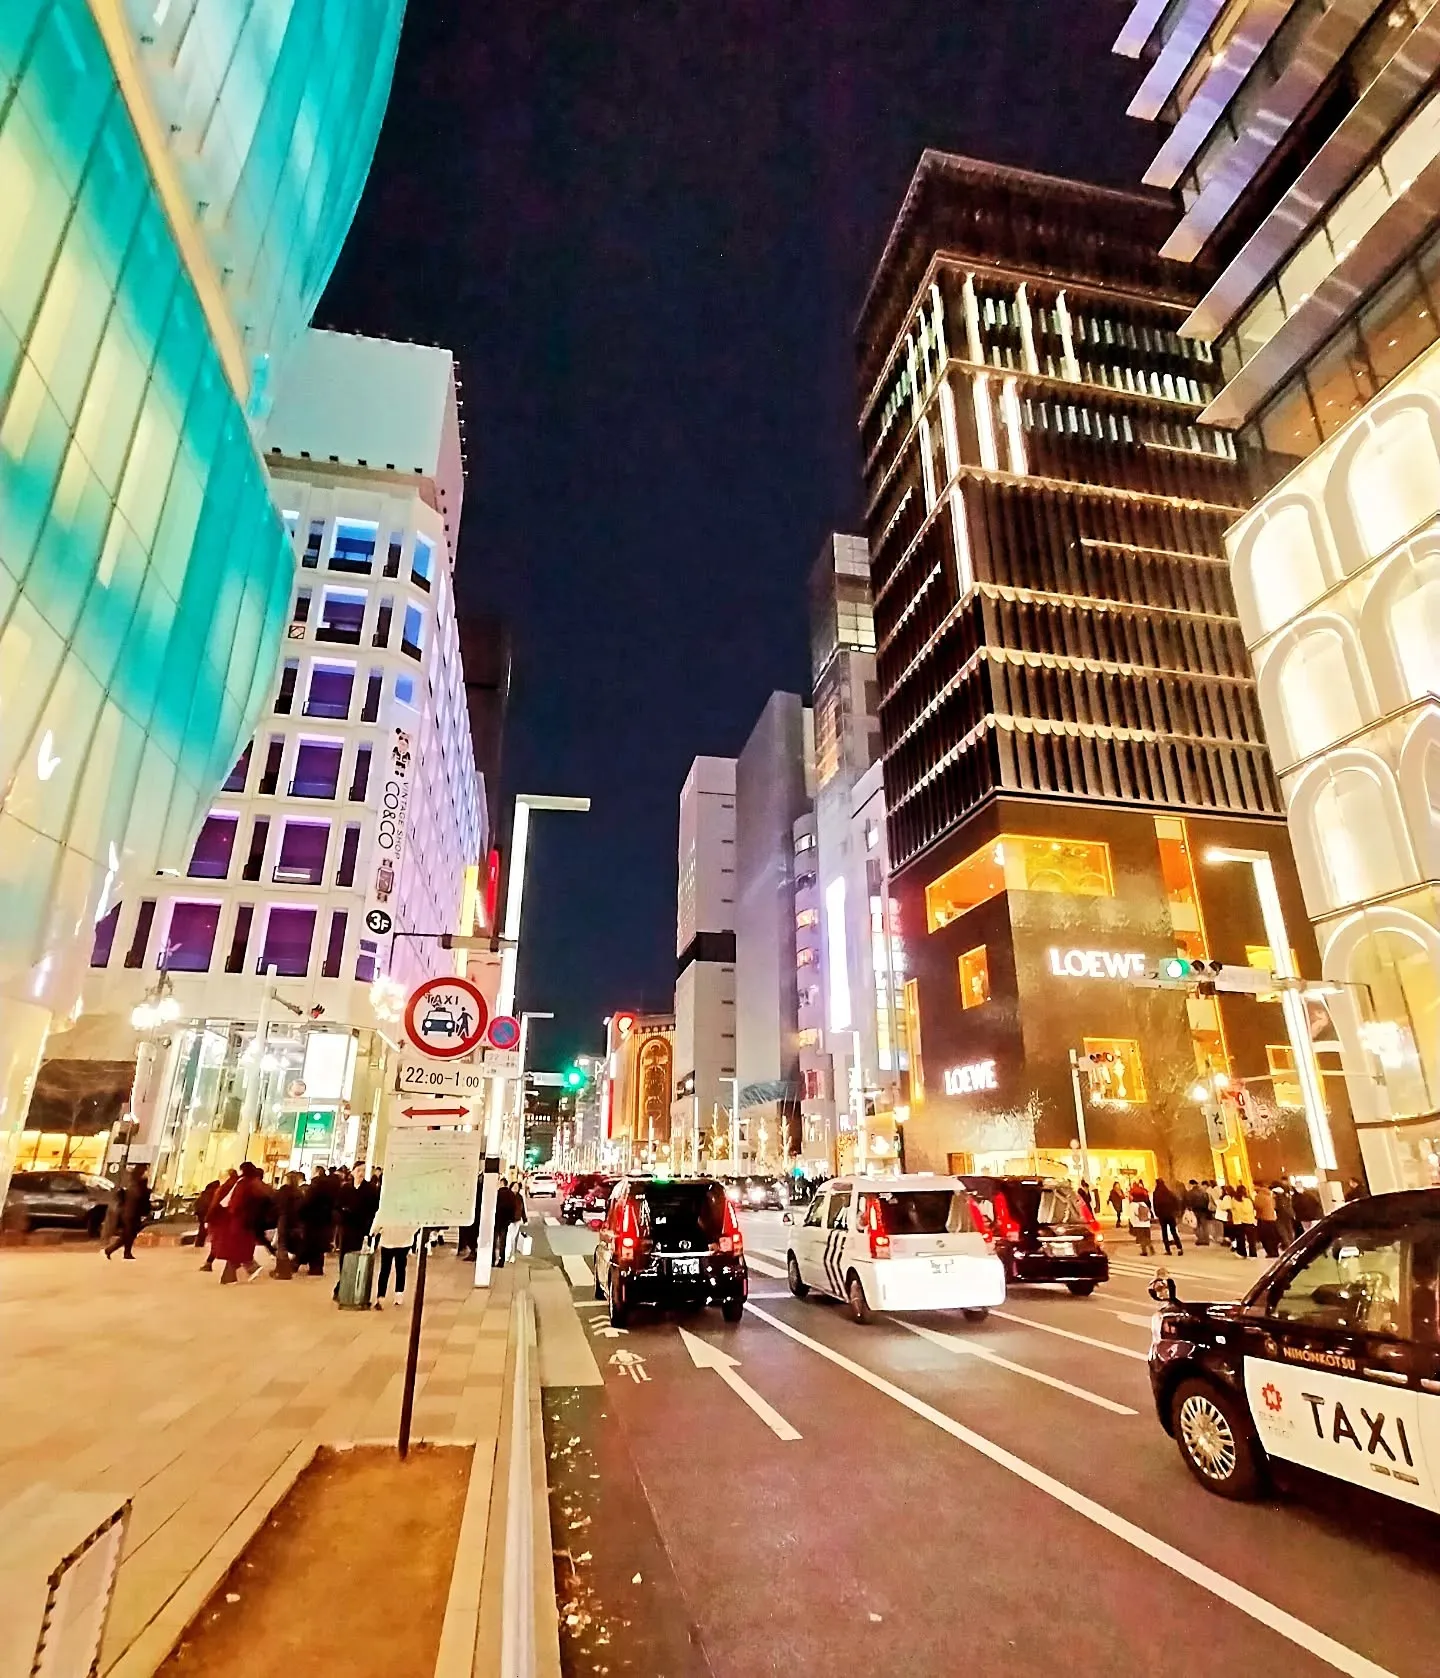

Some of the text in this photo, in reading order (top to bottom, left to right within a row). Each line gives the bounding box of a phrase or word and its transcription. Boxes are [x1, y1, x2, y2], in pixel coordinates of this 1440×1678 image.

[378, 781, 400, 849] CO&CO
[394, 782, 409, 860] VINTAGE SHOP
[369, 912, 390, 931] 3F
[1049, 948, 1146, 979] LOEWE
[425, 993, 459, 1005] TAXI
[944, 1059, 999, 1096] LOEWE
[1283, 1346, 1356, 1371] NIHONKOTSU
[1301, 1392, 1414, 1467] TAXI
